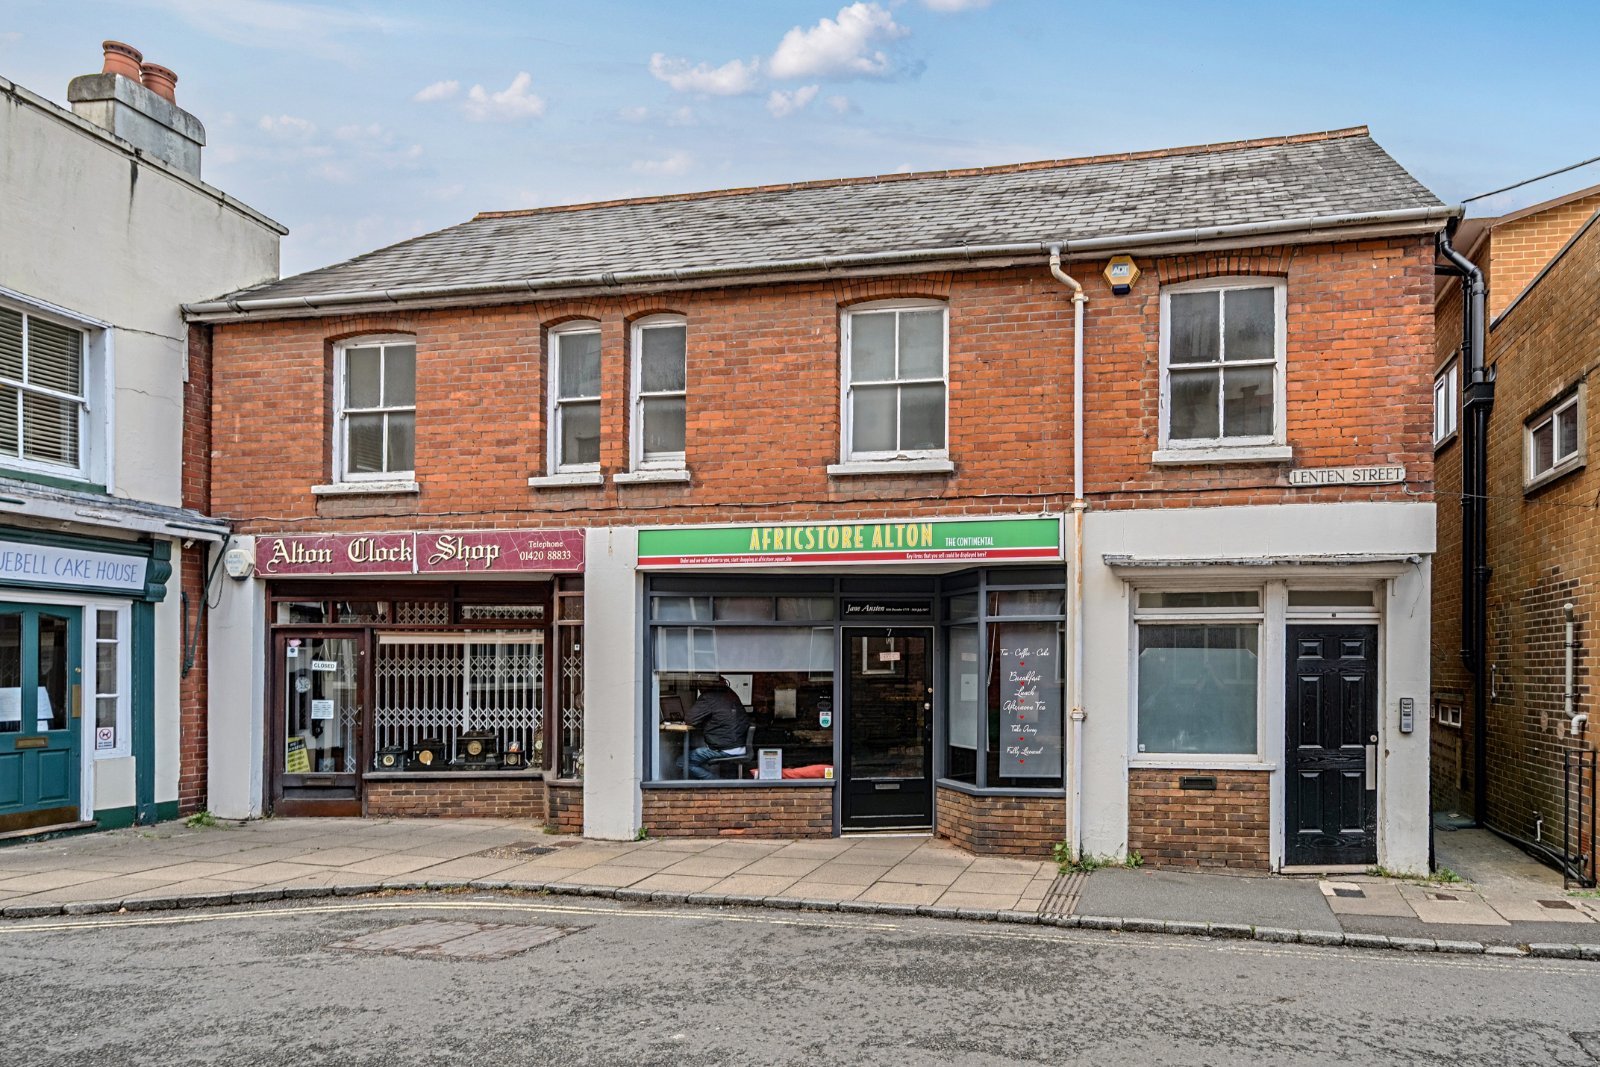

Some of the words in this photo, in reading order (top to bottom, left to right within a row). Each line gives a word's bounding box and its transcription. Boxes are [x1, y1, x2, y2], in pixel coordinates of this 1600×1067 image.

[1112, 265, 1128, 275] ADT
[1293, 470, 1345, 484] LENTEN
[1352, 467, 1402, 482] STREET
[750, 526, 863, 551] AFRICSTORE
[872, 523, 933, 548] ALTON
[945, 537, 956, 547] THE
[956, 536, 994, 547] CONTINENTAL
[528, 539, 564, 549] Telephone
[266, 538, 333, 573] Alton
[347, 536, 412, 563] Clock
[427, 535, 500, 569] Shop
[519, 550, 544, 562] 01420
[547, 549, 571, 561] 88833
[54, 556, 92, 579] CAKE
[96, 560, 138, 583] HOUSE
[845, 604, 861, 614] Jane
[861, 604, 885, 612] Austen
[1000, 648, 1009, 657] Tea
[1014, 648, 1031, 659] Coffee
[1036, 648, 1050, 657] Cake
[1008, 670, 1042, 685] Breakfast
[1014, 685, 1037, 698] Lunch
[1002, 699, 1034, 714] Afternoon
[1034, 701, 1046, 711] Tea
[1010, 724, 1022, 733] Take
[1022, 724, 1038, 736] Away
[1006, 746, 1020, 758] Fully
